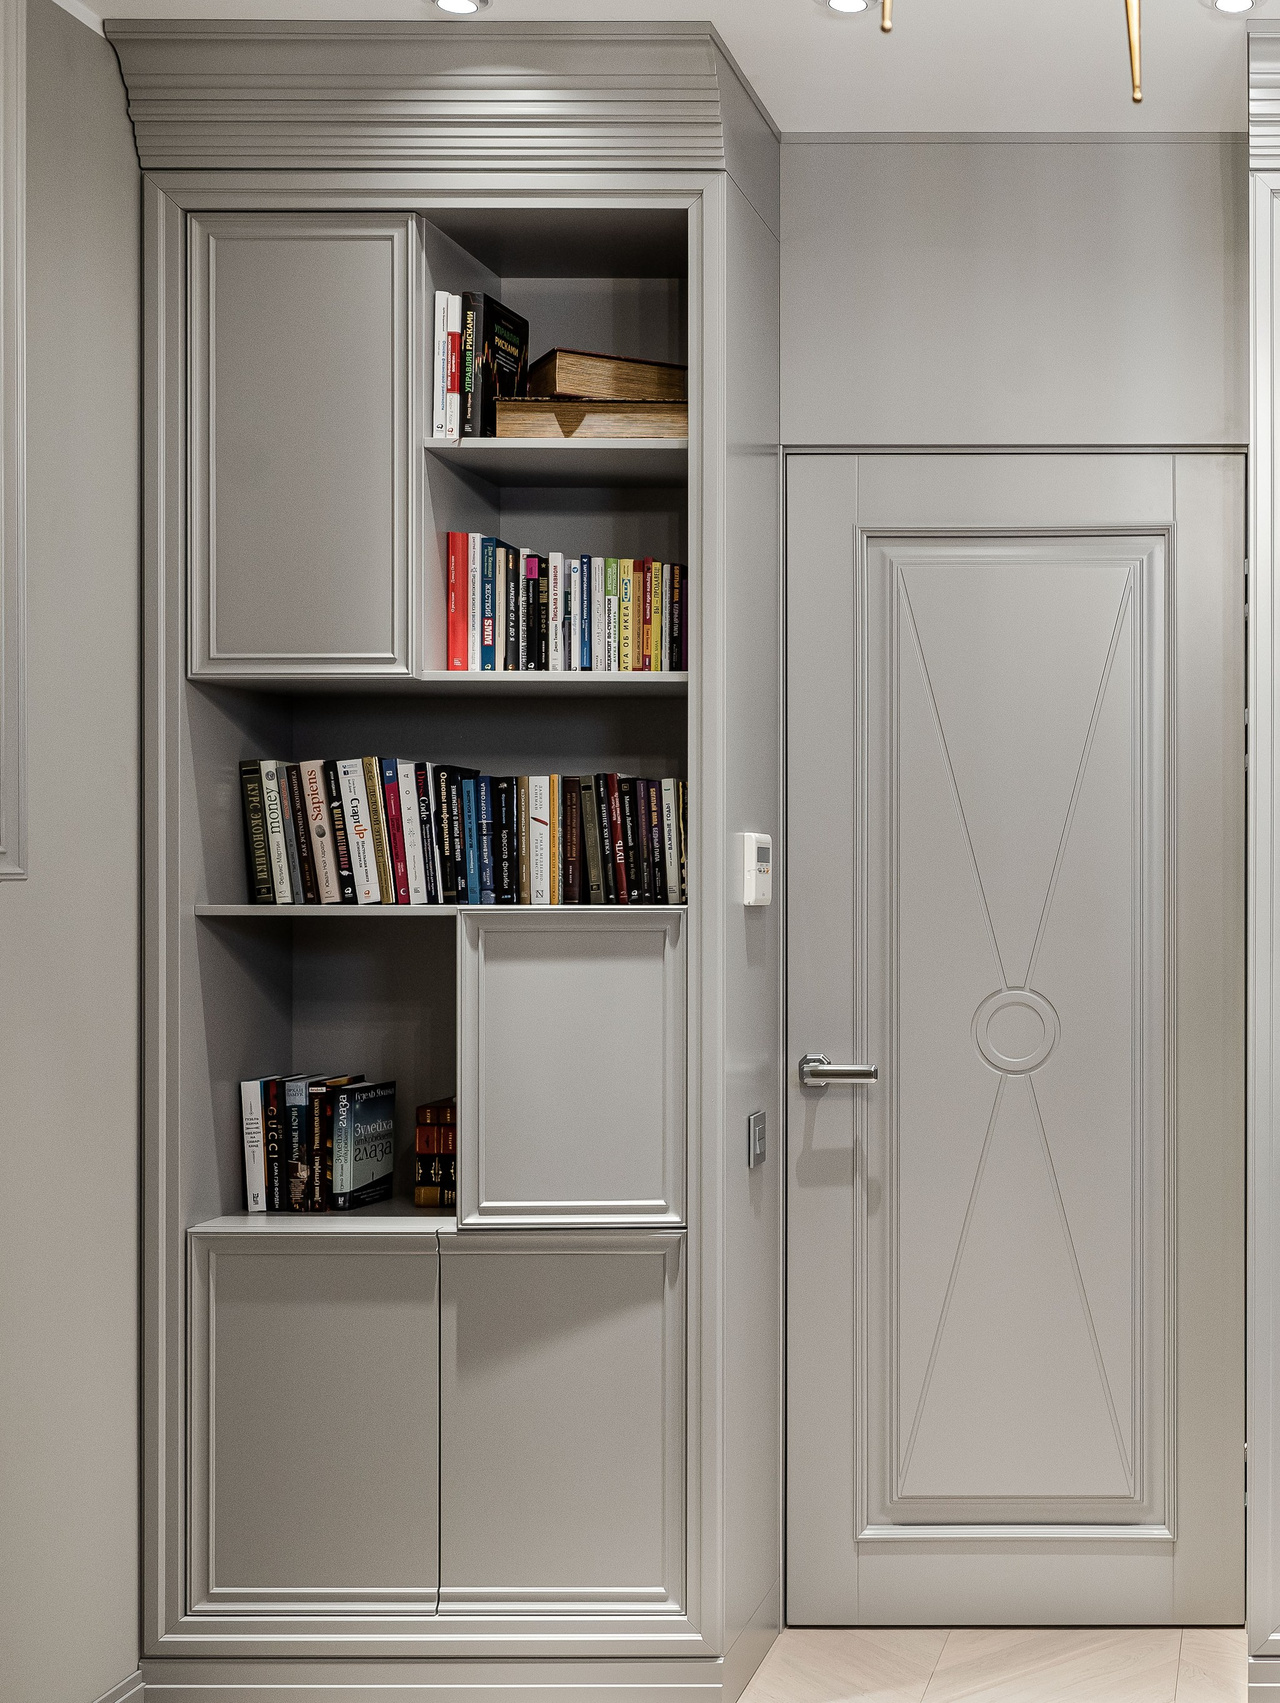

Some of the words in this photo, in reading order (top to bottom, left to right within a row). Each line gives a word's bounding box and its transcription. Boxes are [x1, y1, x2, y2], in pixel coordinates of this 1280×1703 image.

[466, 311, 474, 350] РИСКАМИ
[494, 336, 519, 359] РИСКАМИ
[464, 350, 472, 392] УПРАВЛЯЯ
[540, 577, 548, 603] WAL-MART
[484, 619, 492, 645] SMM
[509, 627, 514, 635] ДО
[247, 783, 260, 809] КУРС
[291, 770, 302, 810] ЭКОНОМИКА
[307, 770, 324, 821] Sapiens
[440, 772, 448, 802] Основы
[266, 787, 281, 834] money
[369, 788, 378, 826] ДЕЛОВОЙ
[297, 811, 306, 842] УСТРОЕНА
[441, 804, 450, 856] информатики
[625, 816, 633, 846] Лабковский
[251, 813, 268, 879] ЭКОНОМИКИ
[373, 827, 383, 858] ЭТИКЕТ
[615, 840, 624, 863] ПУТЬ
[339, 1094, 349, 1127] глаза
[355, 1090, 375, 1102] Гузель
[268, 1106, 278, 1158] GUCCI
[354, 1119, 393, 1136] Зулейха
[354, 1140, 392, 1162] глаза
